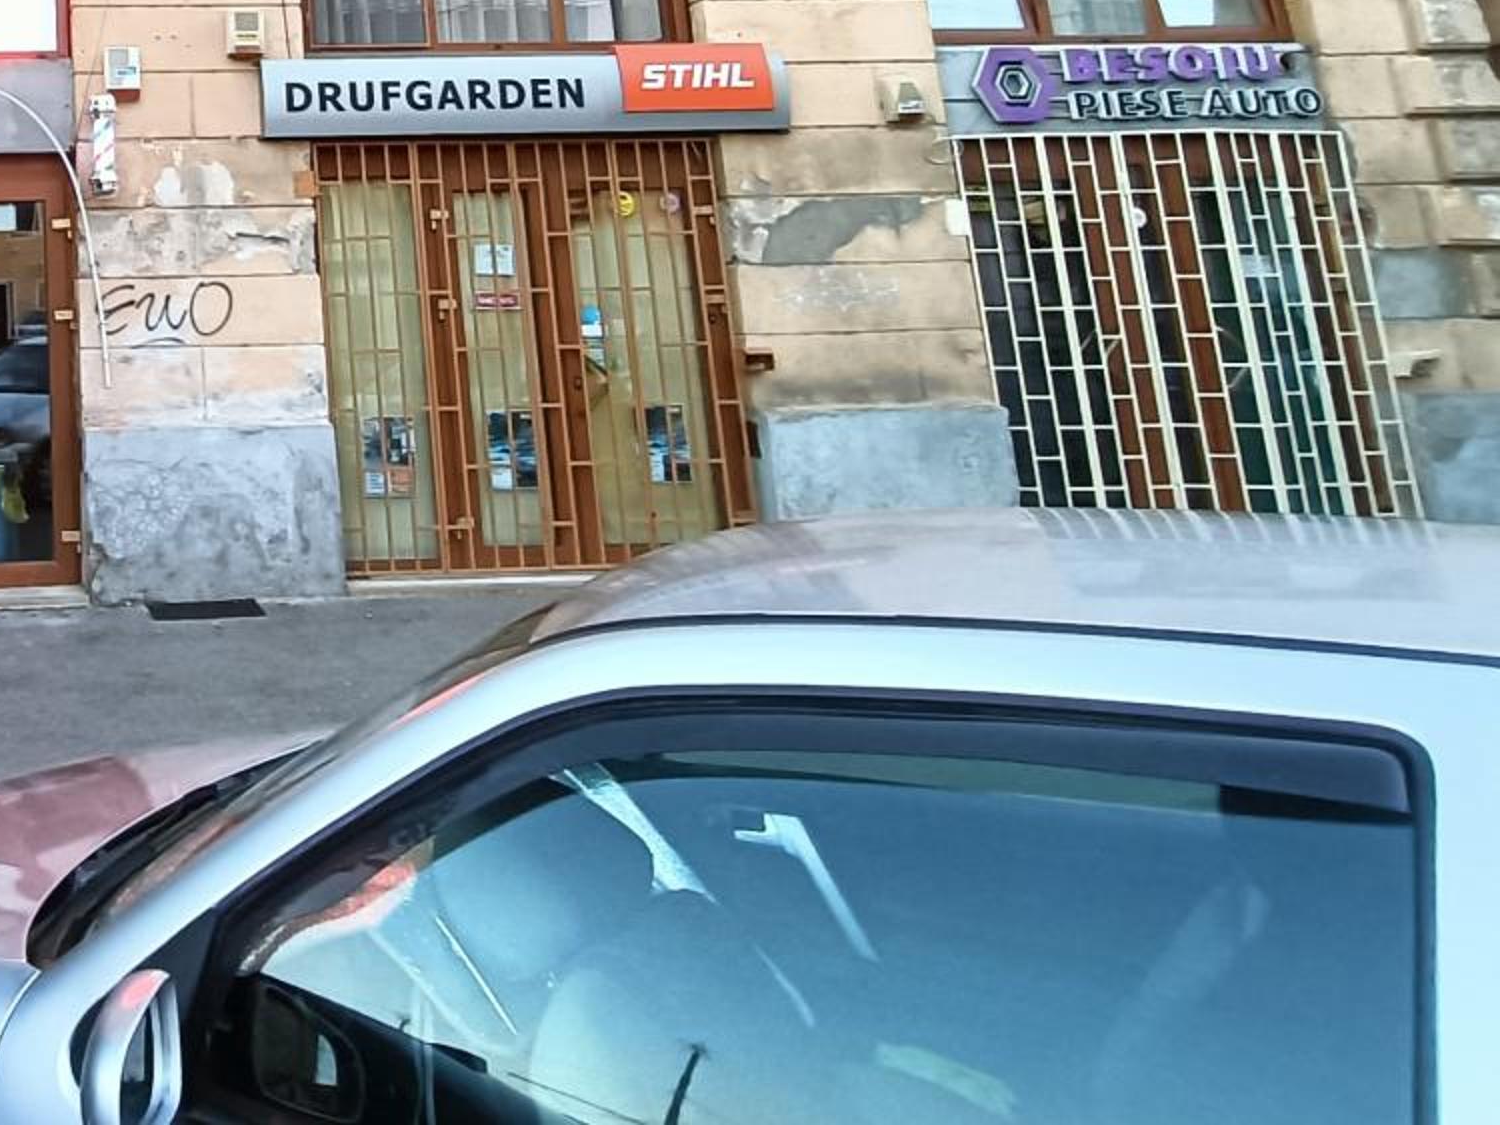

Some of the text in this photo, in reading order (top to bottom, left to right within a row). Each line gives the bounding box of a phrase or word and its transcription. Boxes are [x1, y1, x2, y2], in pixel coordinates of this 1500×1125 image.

[642, 63, 755, 89] STIHL
[285, 78, 585, 112] DRUFGARDEN
[1070, 88, 1321, 119] PIESE AUTO
